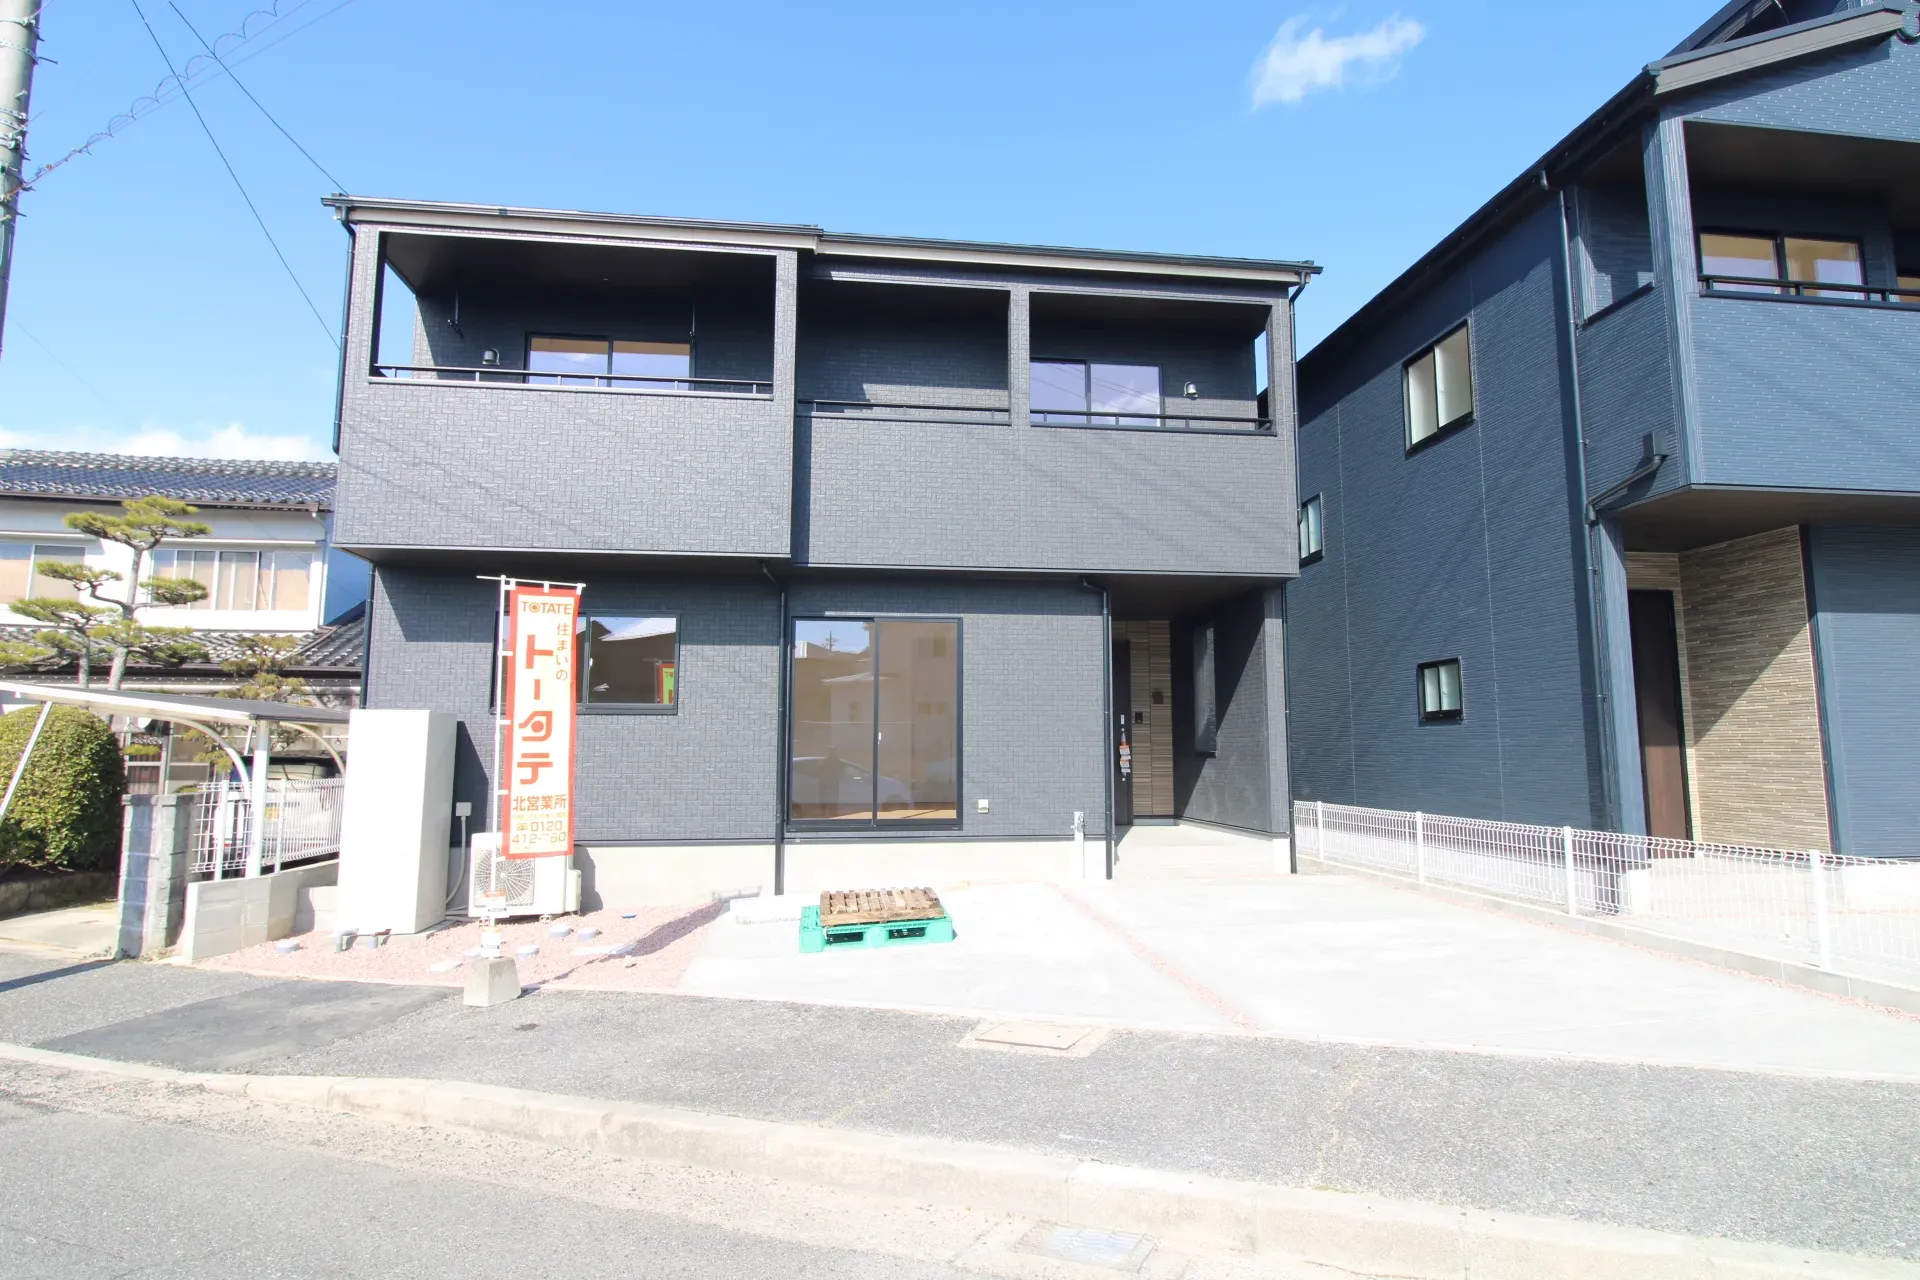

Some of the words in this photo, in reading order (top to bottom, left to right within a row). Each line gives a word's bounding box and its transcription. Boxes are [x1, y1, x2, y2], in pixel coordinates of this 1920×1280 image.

[520, 601, 573, 615] TOTATE
[556, 623, 570, 681] 住まいの
[516, 634, 554, 785] トータテ
[512, 794, 567, 811] 北営業所
[530, 820, 563, 832] 0120
